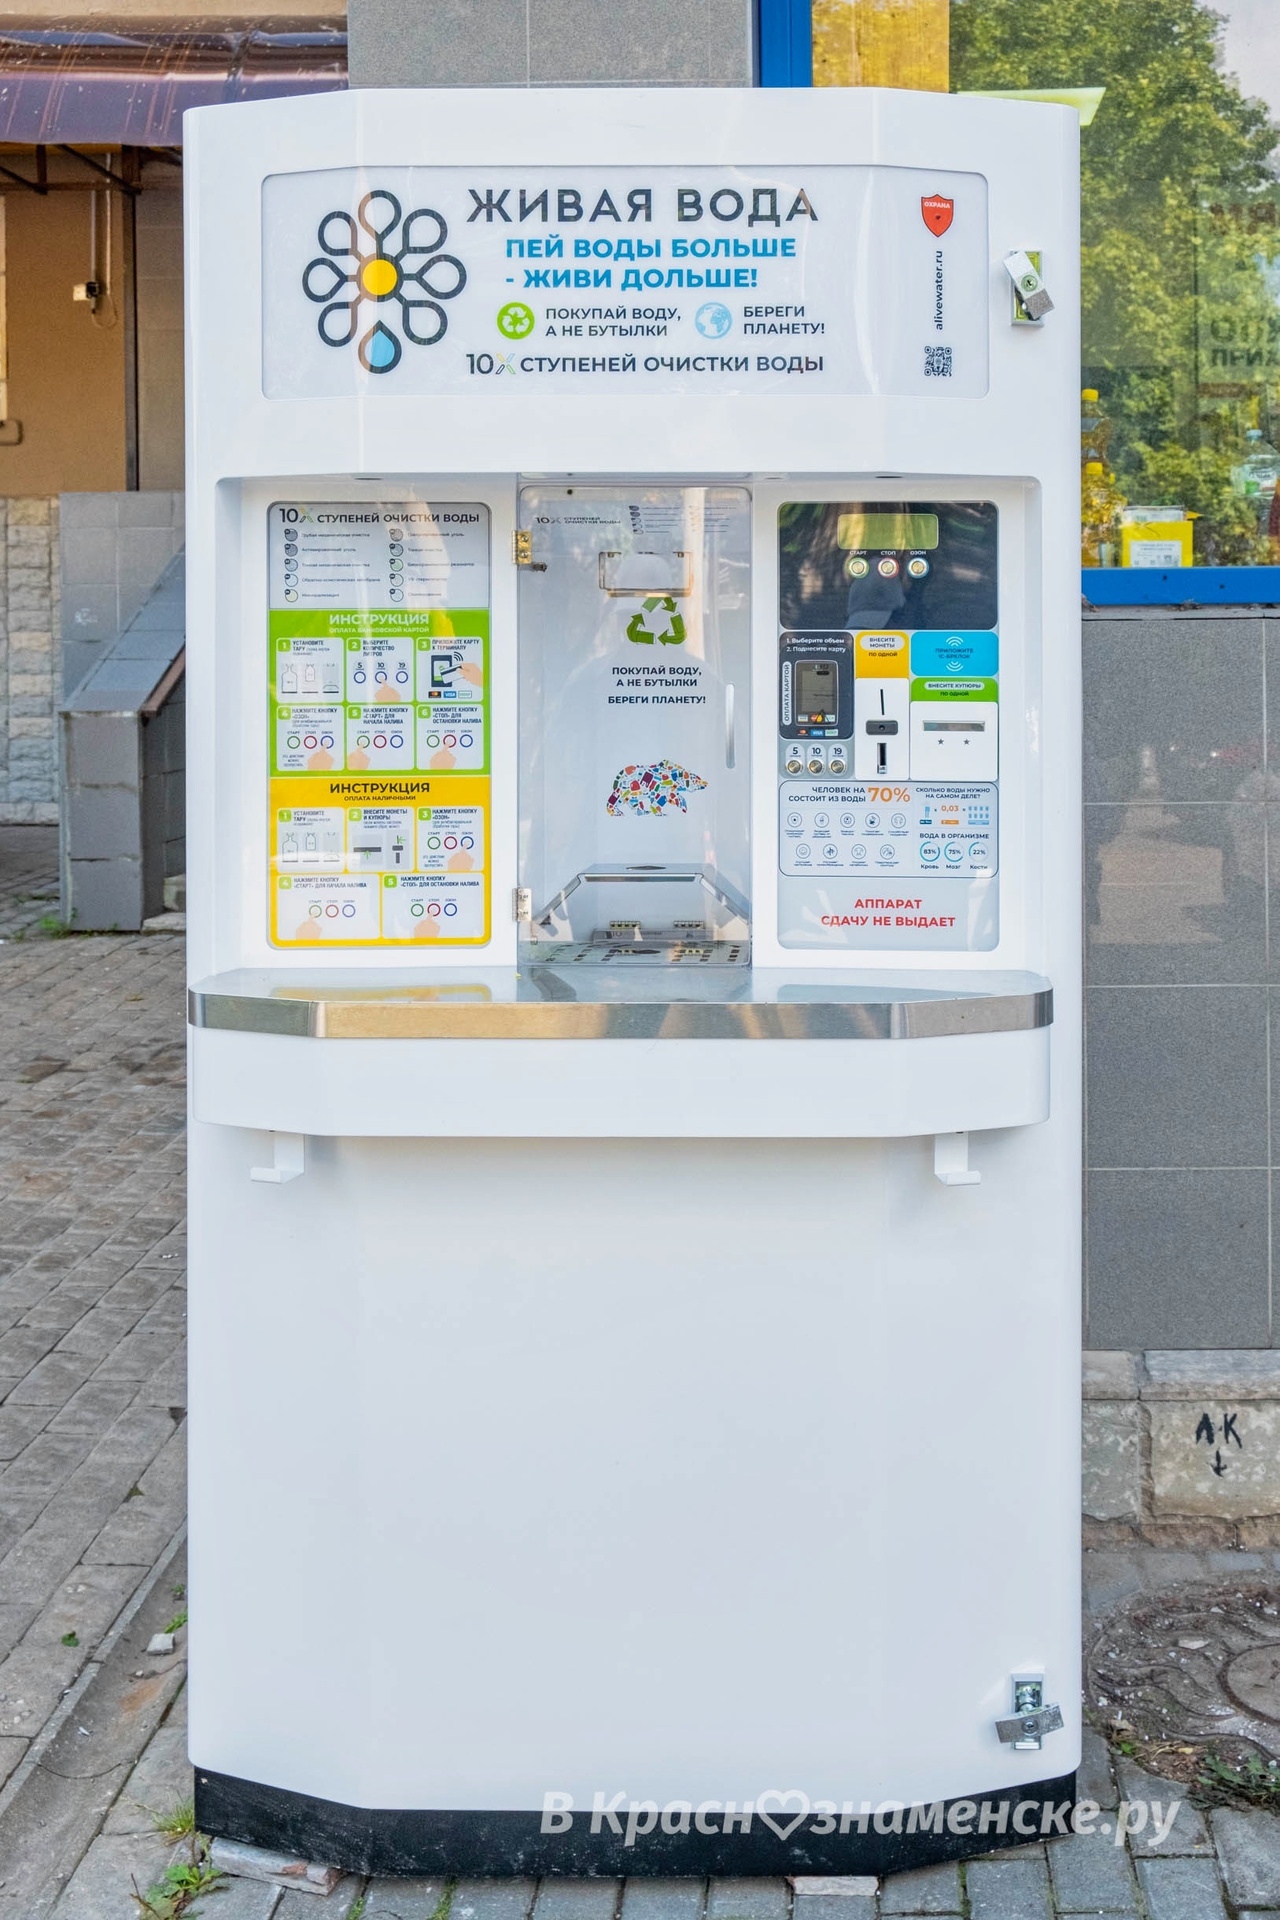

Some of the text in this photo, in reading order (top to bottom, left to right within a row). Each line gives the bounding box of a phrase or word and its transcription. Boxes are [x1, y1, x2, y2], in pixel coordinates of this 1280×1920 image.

[466, 189, 819, 227] ЖИВАЯ ВОДА
[506, 234, 796, 262] ПЕЙ ВОДЫ БОЛЬШЕ
[523, 269, 612, 288] ЖИВИ
[621, 268, 758, 292] ДОЛЬШЕ!
[934, 251, 943, 330] alivewater.ru
[546, 304, 682, 322] ПОКУПАЙ ВОДУ,
[744, 305, 805, 318] БЕРЕГИ
[546, 324, 668, 337] А НЕ БУТЫЛКИ
[744, 322, 825, 336] ПЛАНЕТУ!
[520, 352, 636, 373] СТУПЕНЕЙ
[644, 355, 749, 373] ОЧИСТКИ
[757, 355, 824, 375] ВОДЫ
[317, 512, 380, 523] СТУПЕНЕЙ
[383, 513, 440, 522] ОЧИСТКИ
[443, 514, 480, 524] ВОДЫ
[329, 613, 429, 626] ИНСТРУКЦИЯ
[612, 666, 702, 677] ПОКУПАЙ ВОДУ,
[616, 679, 698, 687] А НЕ БУТЫЛКИ
[608, 696, 706, 704] БЕРЕГИ ПЛАНЕТУ!
[833, 747, 842, 755] 19
[330, 782, 430, 794] ИНСТРУКЦИЯ
[868, 787, 911, 803] 70%
[941, 805, 959, 813] 0,03
[854, 898, 922, 909] АППАРАТ
[821, 915, 956, 928] СДАЧУ НЕ ВЫДАЕТ
